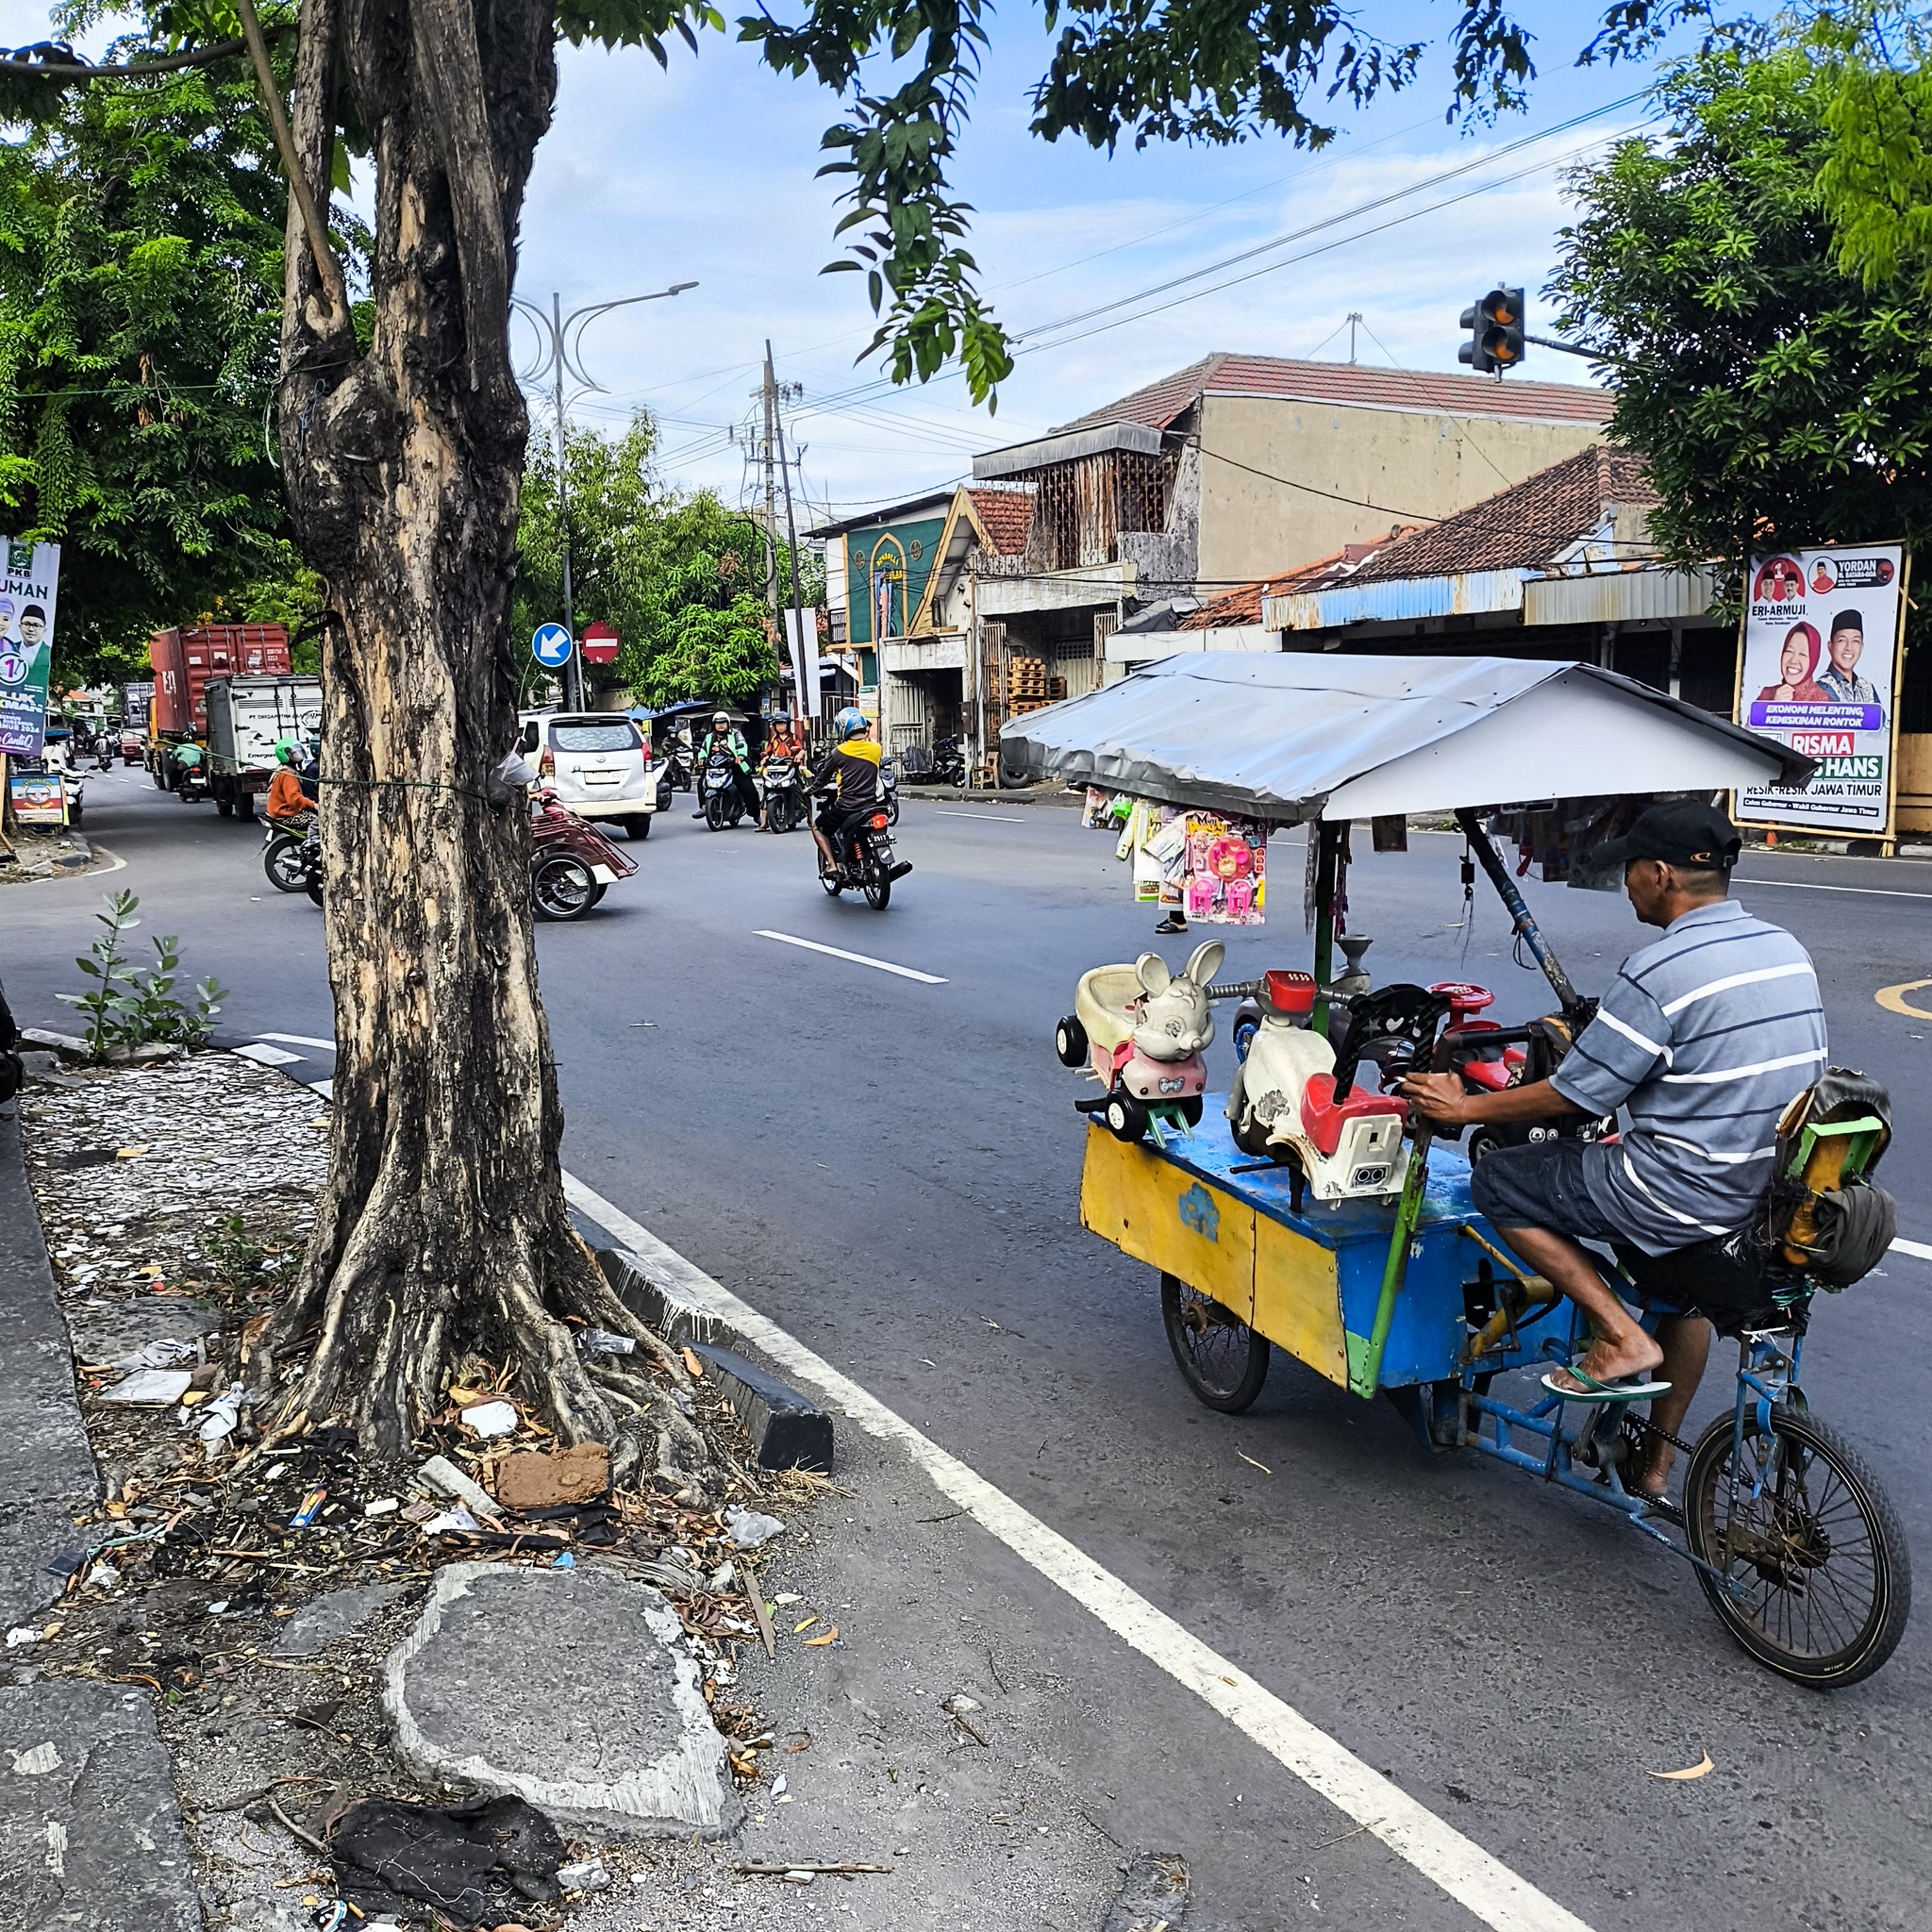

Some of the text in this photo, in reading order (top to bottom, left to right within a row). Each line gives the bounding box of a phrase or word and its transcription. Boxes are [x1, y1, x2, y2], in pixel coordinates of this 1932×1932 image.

[1774, 562, 1785, 579] 1
[1839, 559, 1877, 572] YORDAN
[8, 568, 30, 577] PKB
[1752, 605, 1806, 616] ERI-ARMUJI
[4, 658, 14, 677] 1
[1766, 704, 1864, 717] EKONOMI MELENTING,
[1765, 716, 1863, 726] KEMISKINAN RONTOK
[21, 724, 40, 734] 2024
[1793, 735, 1852, 755] RISMA
[1825, 758, 1879, 777] HANS
[1811, 784, 1843, 796] JAWA
[1846, 784, 1882, 796] TIMUR
[1744, 798, 1760, 807] Calon
[1761, 800, 1788, 808] Gubernur
[1792, 802, 1809, 810] Wakil
[1810, 804, 1840, 812] Gubernur
[1858, 807, 1877, 815] Timur
